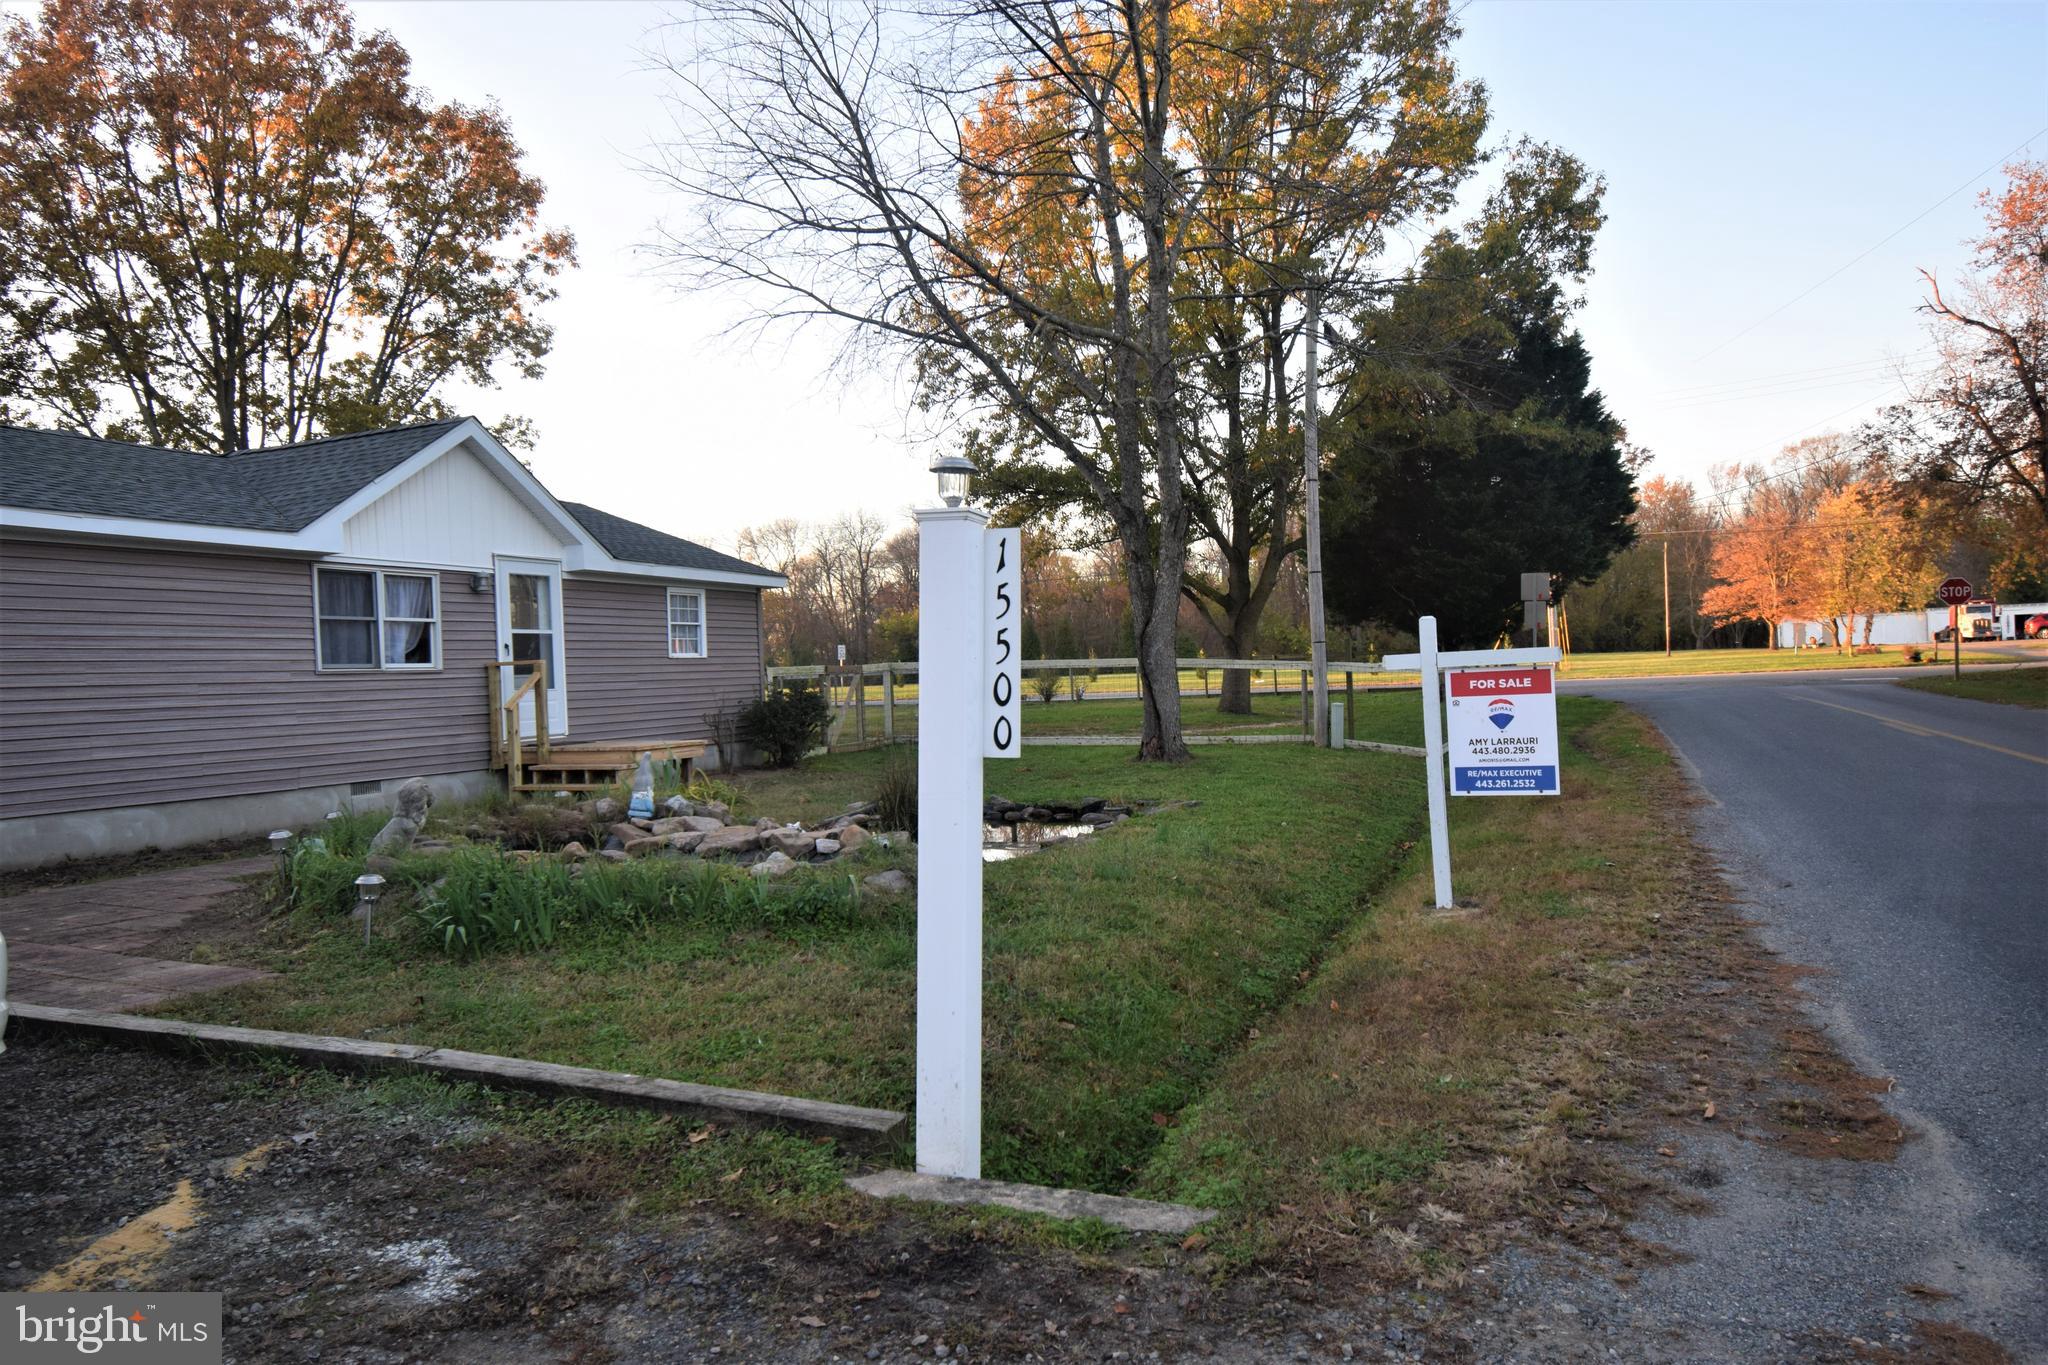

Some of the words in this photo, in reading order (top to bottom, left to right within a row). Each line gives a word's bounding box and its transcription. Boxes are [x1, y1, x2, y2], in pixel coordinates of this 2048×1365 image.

[1941, 585, 1971, 598] STOP
[993, 537, 1012, 750] 15500
[1469, 680, 1496, 689] FOR
[1498, 678, 1532, 688] SALE
[1468, 738, 1489, 746] AMY
[1491, 737, 1539, 746] LARRAURI
[1471, 746, 1536, 755] 443.480.2936
[1500, 769, 1542, 777] EXECUTIVE
[1475, 779, 1536, 788] 443.261.2532
